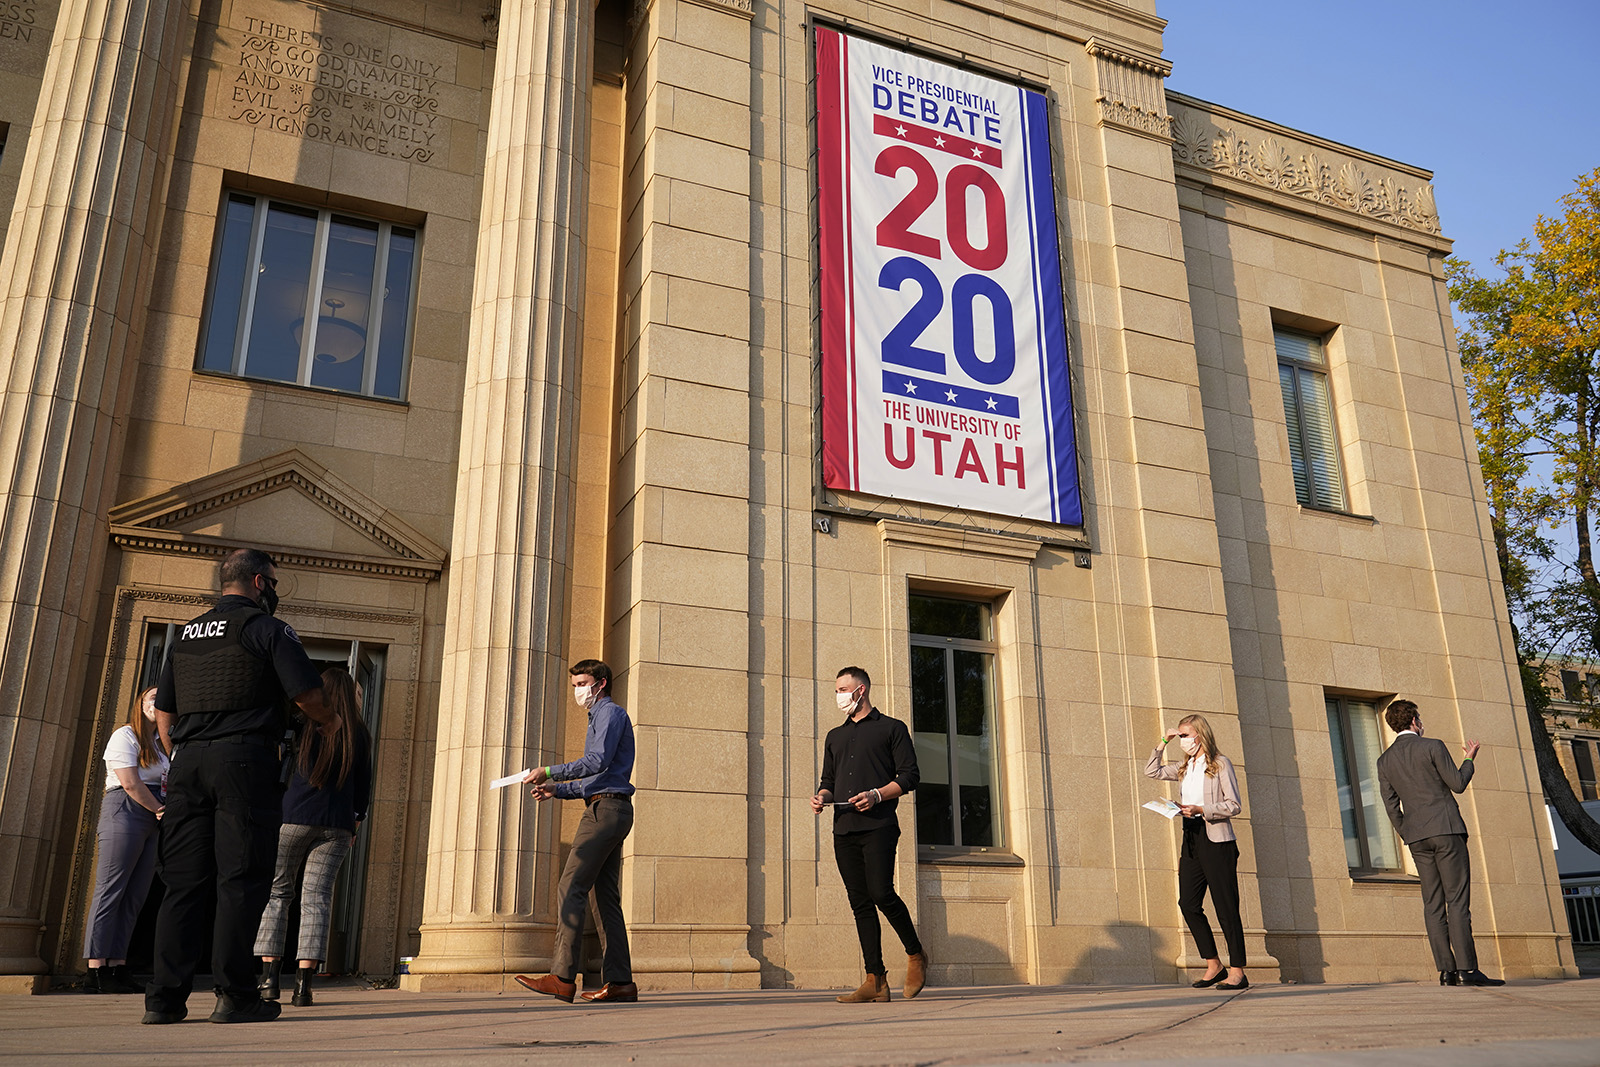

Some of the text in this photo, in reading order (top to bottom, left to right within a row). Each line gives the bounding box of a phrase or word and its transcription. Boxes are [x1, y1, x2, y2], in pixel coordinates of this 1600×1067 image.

[245, 16, 442, 78] THERE IS ONE ONLY
[235, 69, 438, 129] AND ONE ONLY
[872, 64, 1000, 116] VICE PRESIDENTIAL
[873, 83, 1002, 144] DEBATE
[349, 114, 436, 146] NAMELY
[874, 144, 1009, 272] 20
[878, 255, 1016, 386] 20
[882, 399, 1022, 442] THE UNIVERSITY OF
[883, 422, 1027, 490] UTAH
[181, 620, 227, 640] POLICE
